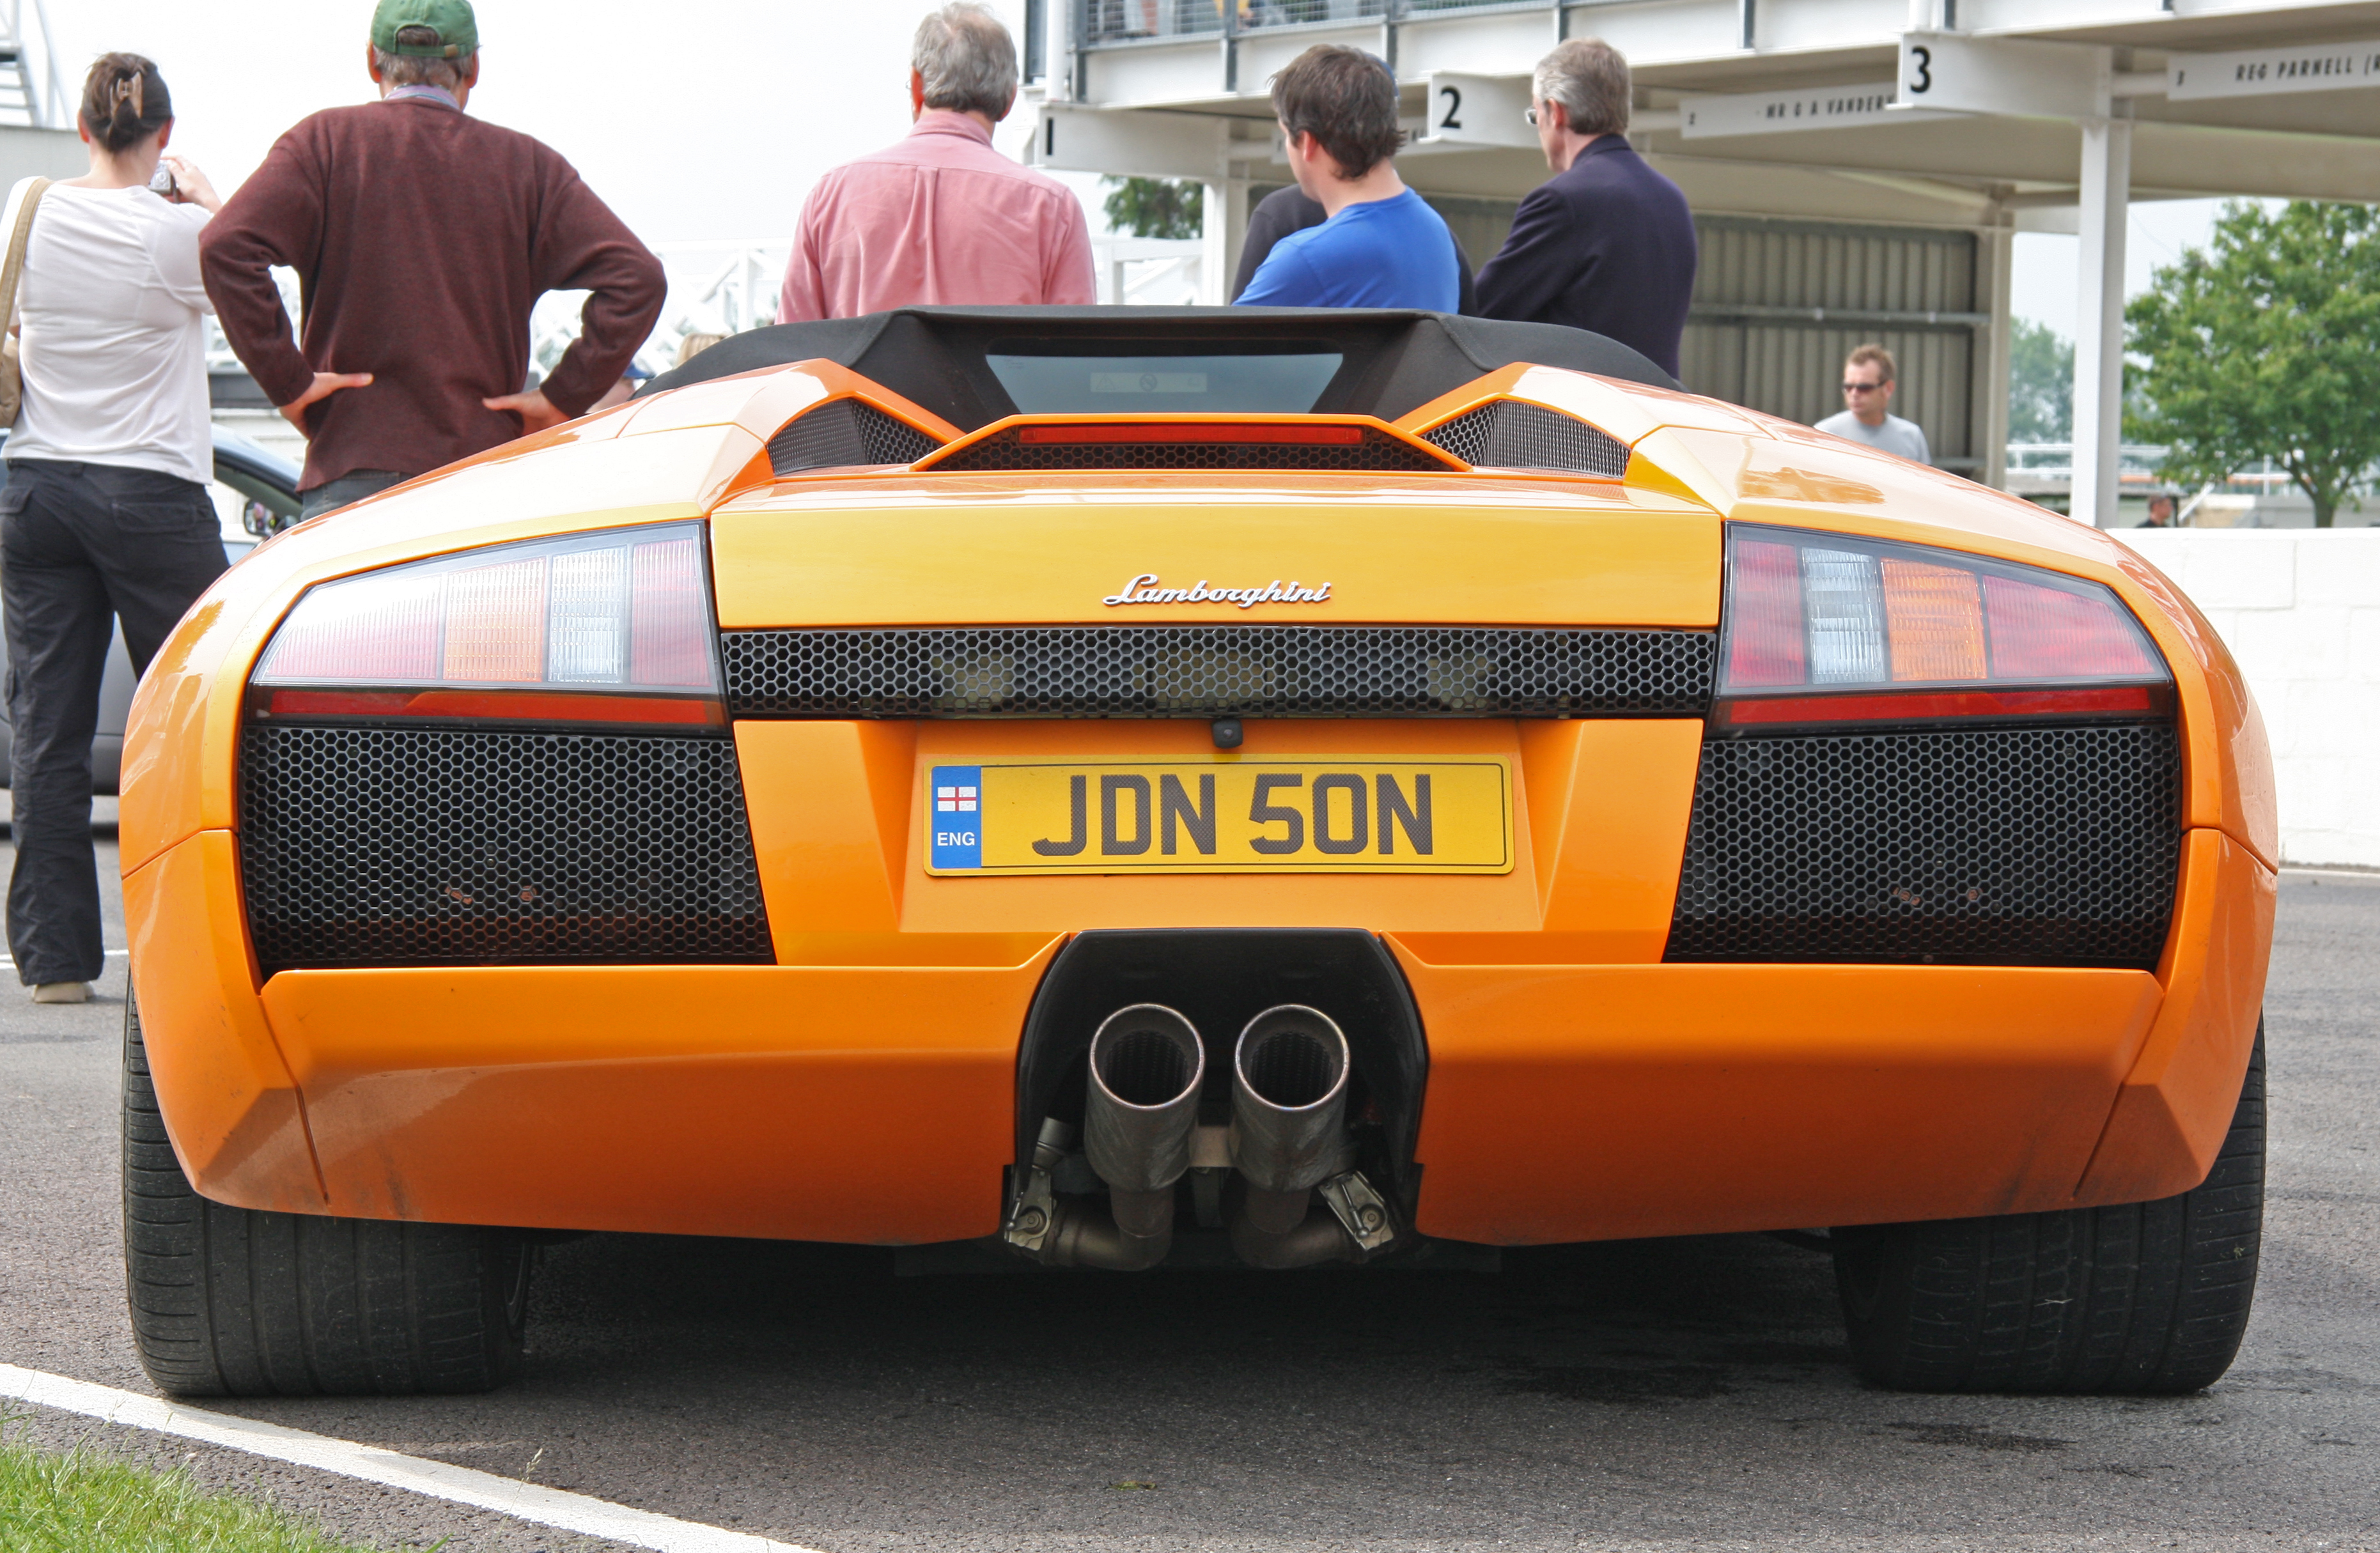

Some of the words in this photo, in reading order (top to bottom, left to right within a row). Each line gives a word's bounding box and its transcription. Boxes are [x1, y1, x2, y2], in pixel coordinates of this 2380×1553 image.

[1909, 45, 1931, 94] 3
[2235, 63, 2267, 81] REG
[2276, 56, 2353, 79] PARNELL
[1440, 85, 1462, 129] 2
[1810, 100, 1818, 116] A
[1102, 574, 1332, 609] Lamborghini
[1031, 773, 1216, 856] JDN
[937, 831, 976, 847] ENG
